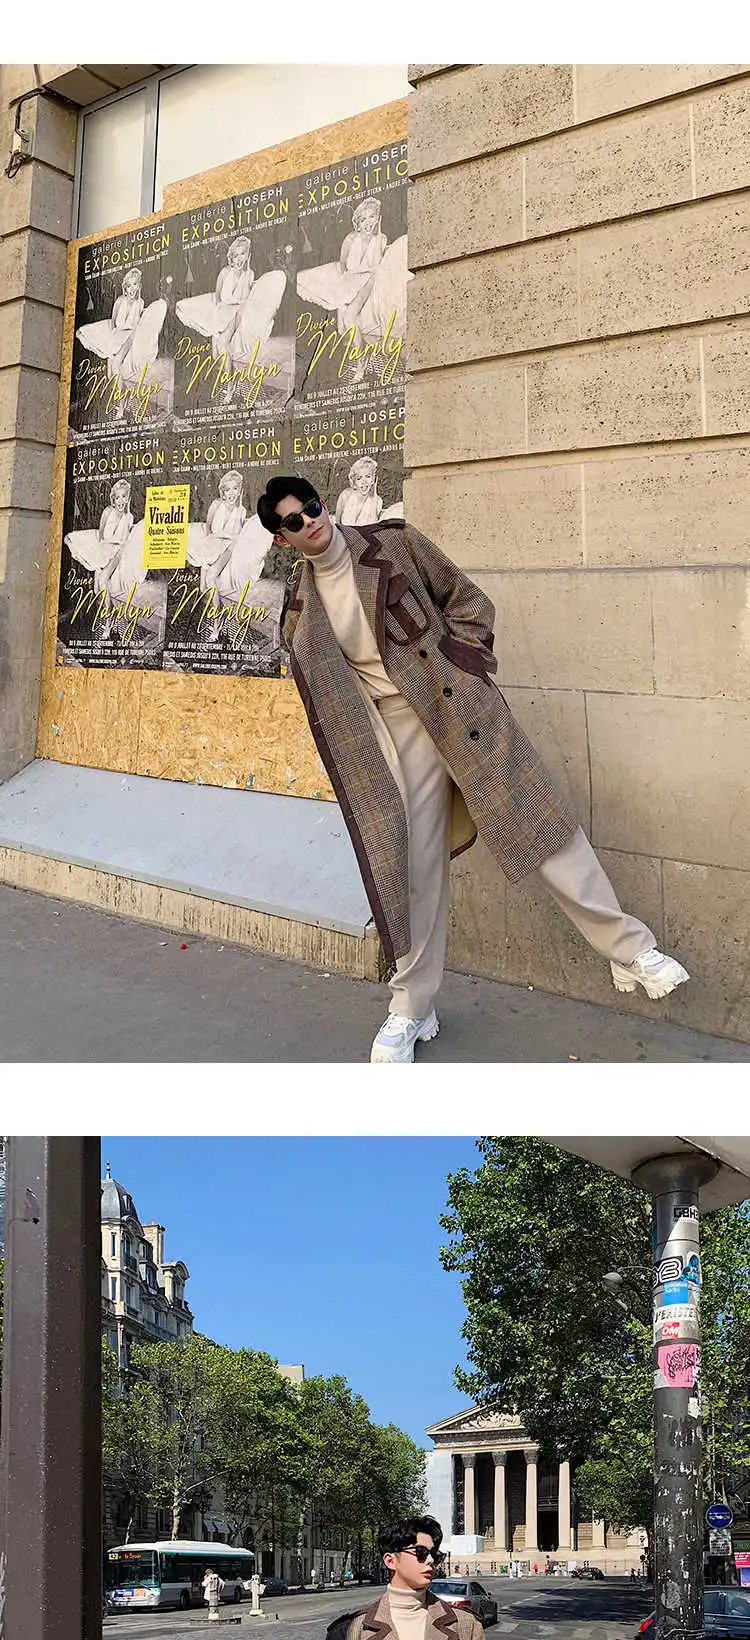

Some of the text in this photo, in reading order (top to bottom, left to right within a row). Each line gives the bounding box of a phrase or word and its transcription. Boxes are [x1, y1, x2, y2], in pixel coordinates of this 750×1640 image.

[305, 166, 348, 190] galerie
[190, 185, 283, 225] galerie JOSEPH
[182, 197, 289, 242] EXPOSITION
[92, 239, 122, 258] galerie
[185, 338, 281, 409] Marilyn
[180, 427, 275, 448] galerie JOSEPH
[303, 417, 346, 435] galerie
[77, 445, 109, 459] galerie
[119, 438, 159, 452] JOSEPH
[173, 440, 281, 464] EXPOSITION
[72, 450, 165, 477] EXPOSITION
[149, 505, 185, 525] Vivaldi
[148, 525, 185, 537] Quatre Saisons
[70, 579, 158, 642] Marilyn
[171, 578, 273, 651] Marilyn
